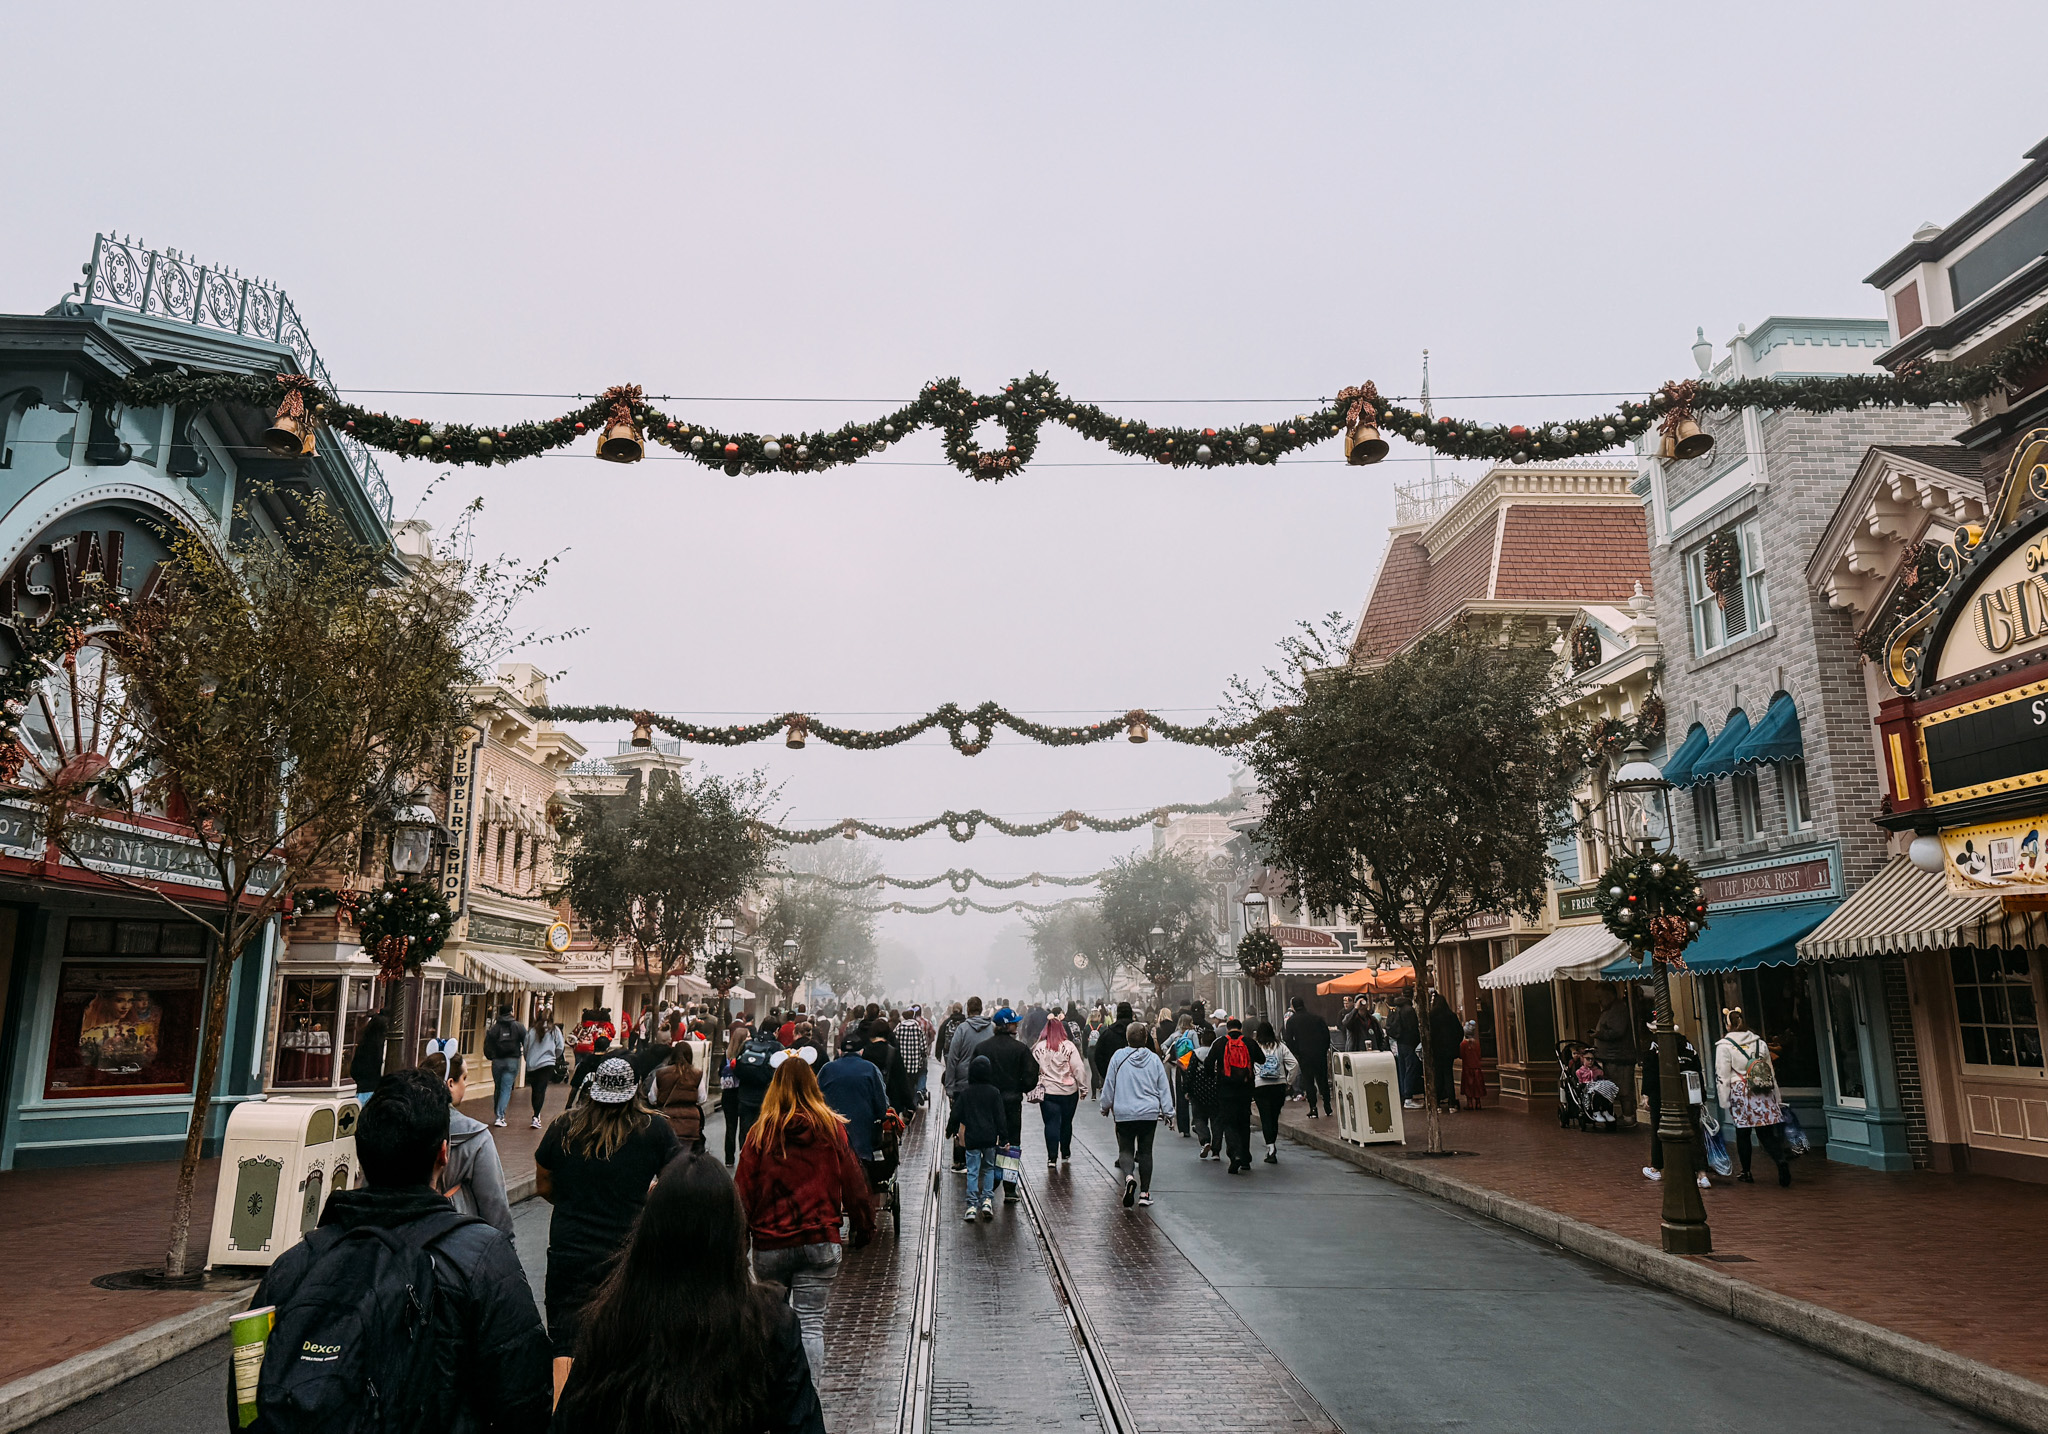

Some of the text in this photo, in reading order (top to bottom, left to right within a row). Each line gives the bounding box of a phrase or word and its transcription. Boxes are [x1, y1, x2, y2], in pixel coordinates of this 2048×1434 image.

[445, 749, 468, 900] JEWELRY SHOP
[71, 832, 219, 876] DISNEYLAND
[1717, 871, 1800, 897] THE BOOK REST
[1466, 916, 1481, 929] RARE
[1483, 914, 1503, 926] SPICES
[1270, 928, 1324, 945] CLOTHIERS
[303, 1341, 340, 1353] Dexco
